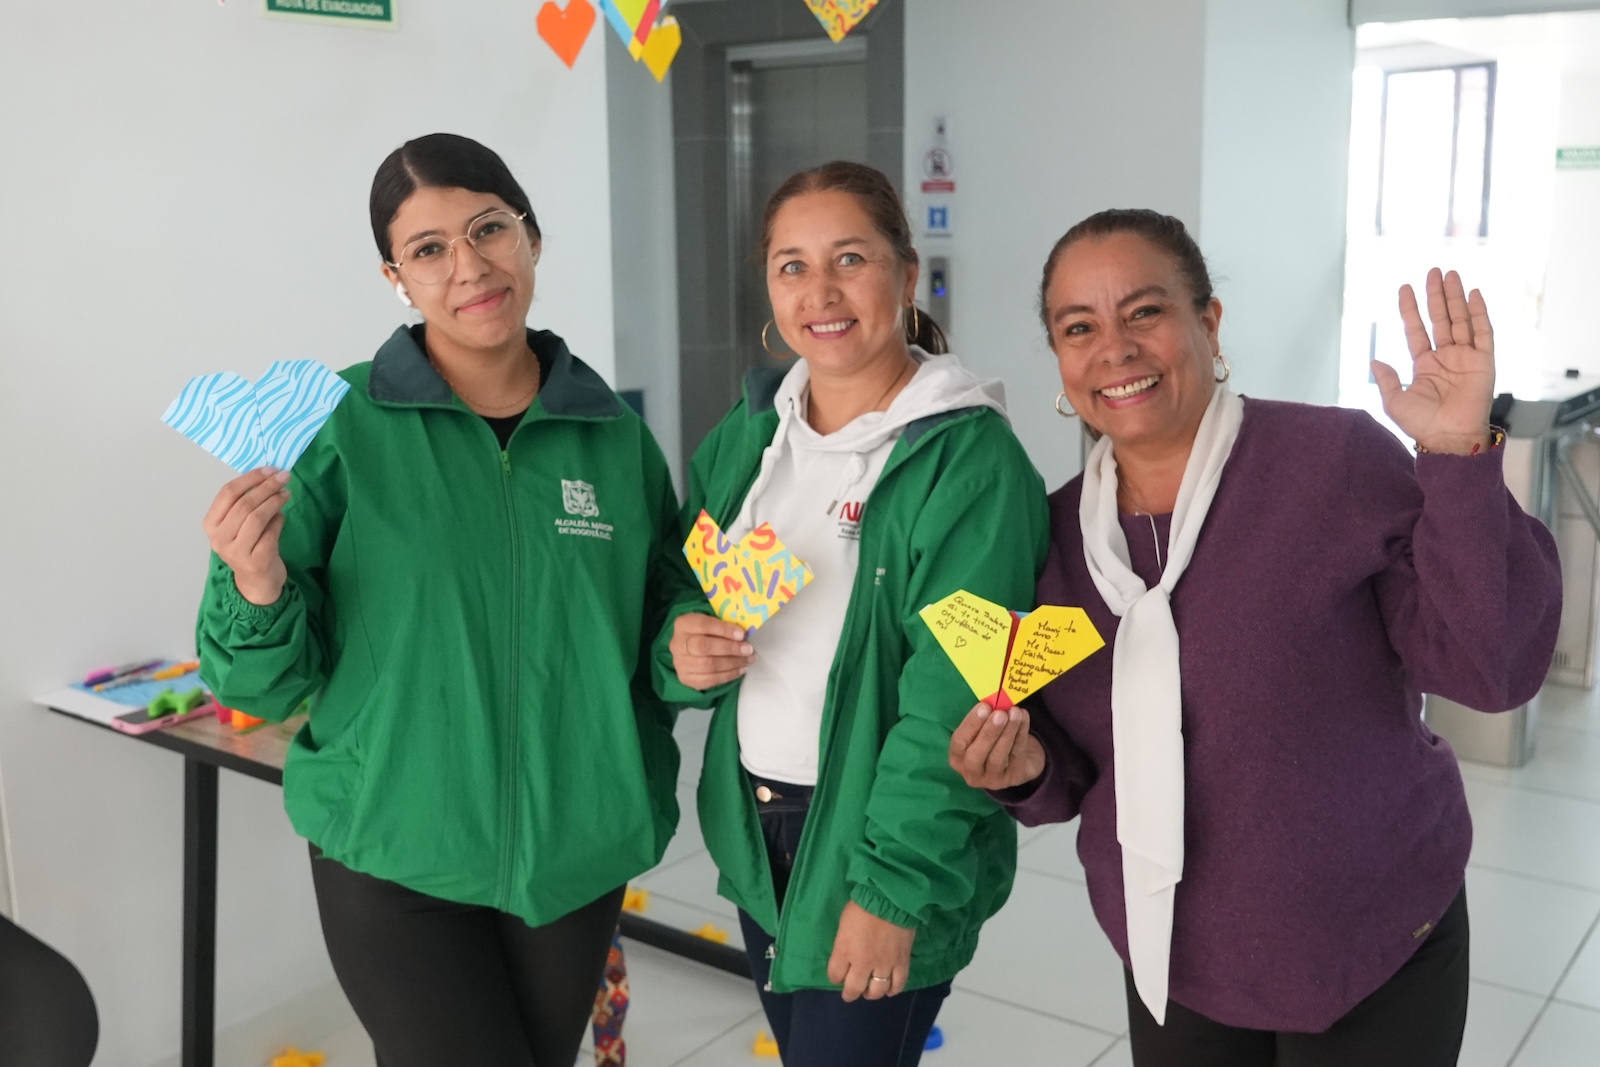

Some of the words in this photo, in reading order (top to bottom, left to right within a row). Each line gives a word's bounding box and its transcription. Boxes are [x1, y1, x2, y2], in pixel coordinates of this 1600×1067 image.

[305, 0, 320, 10] DE
[1064, 620, 1077, 633] te
[982, 632, 992, 641] de
